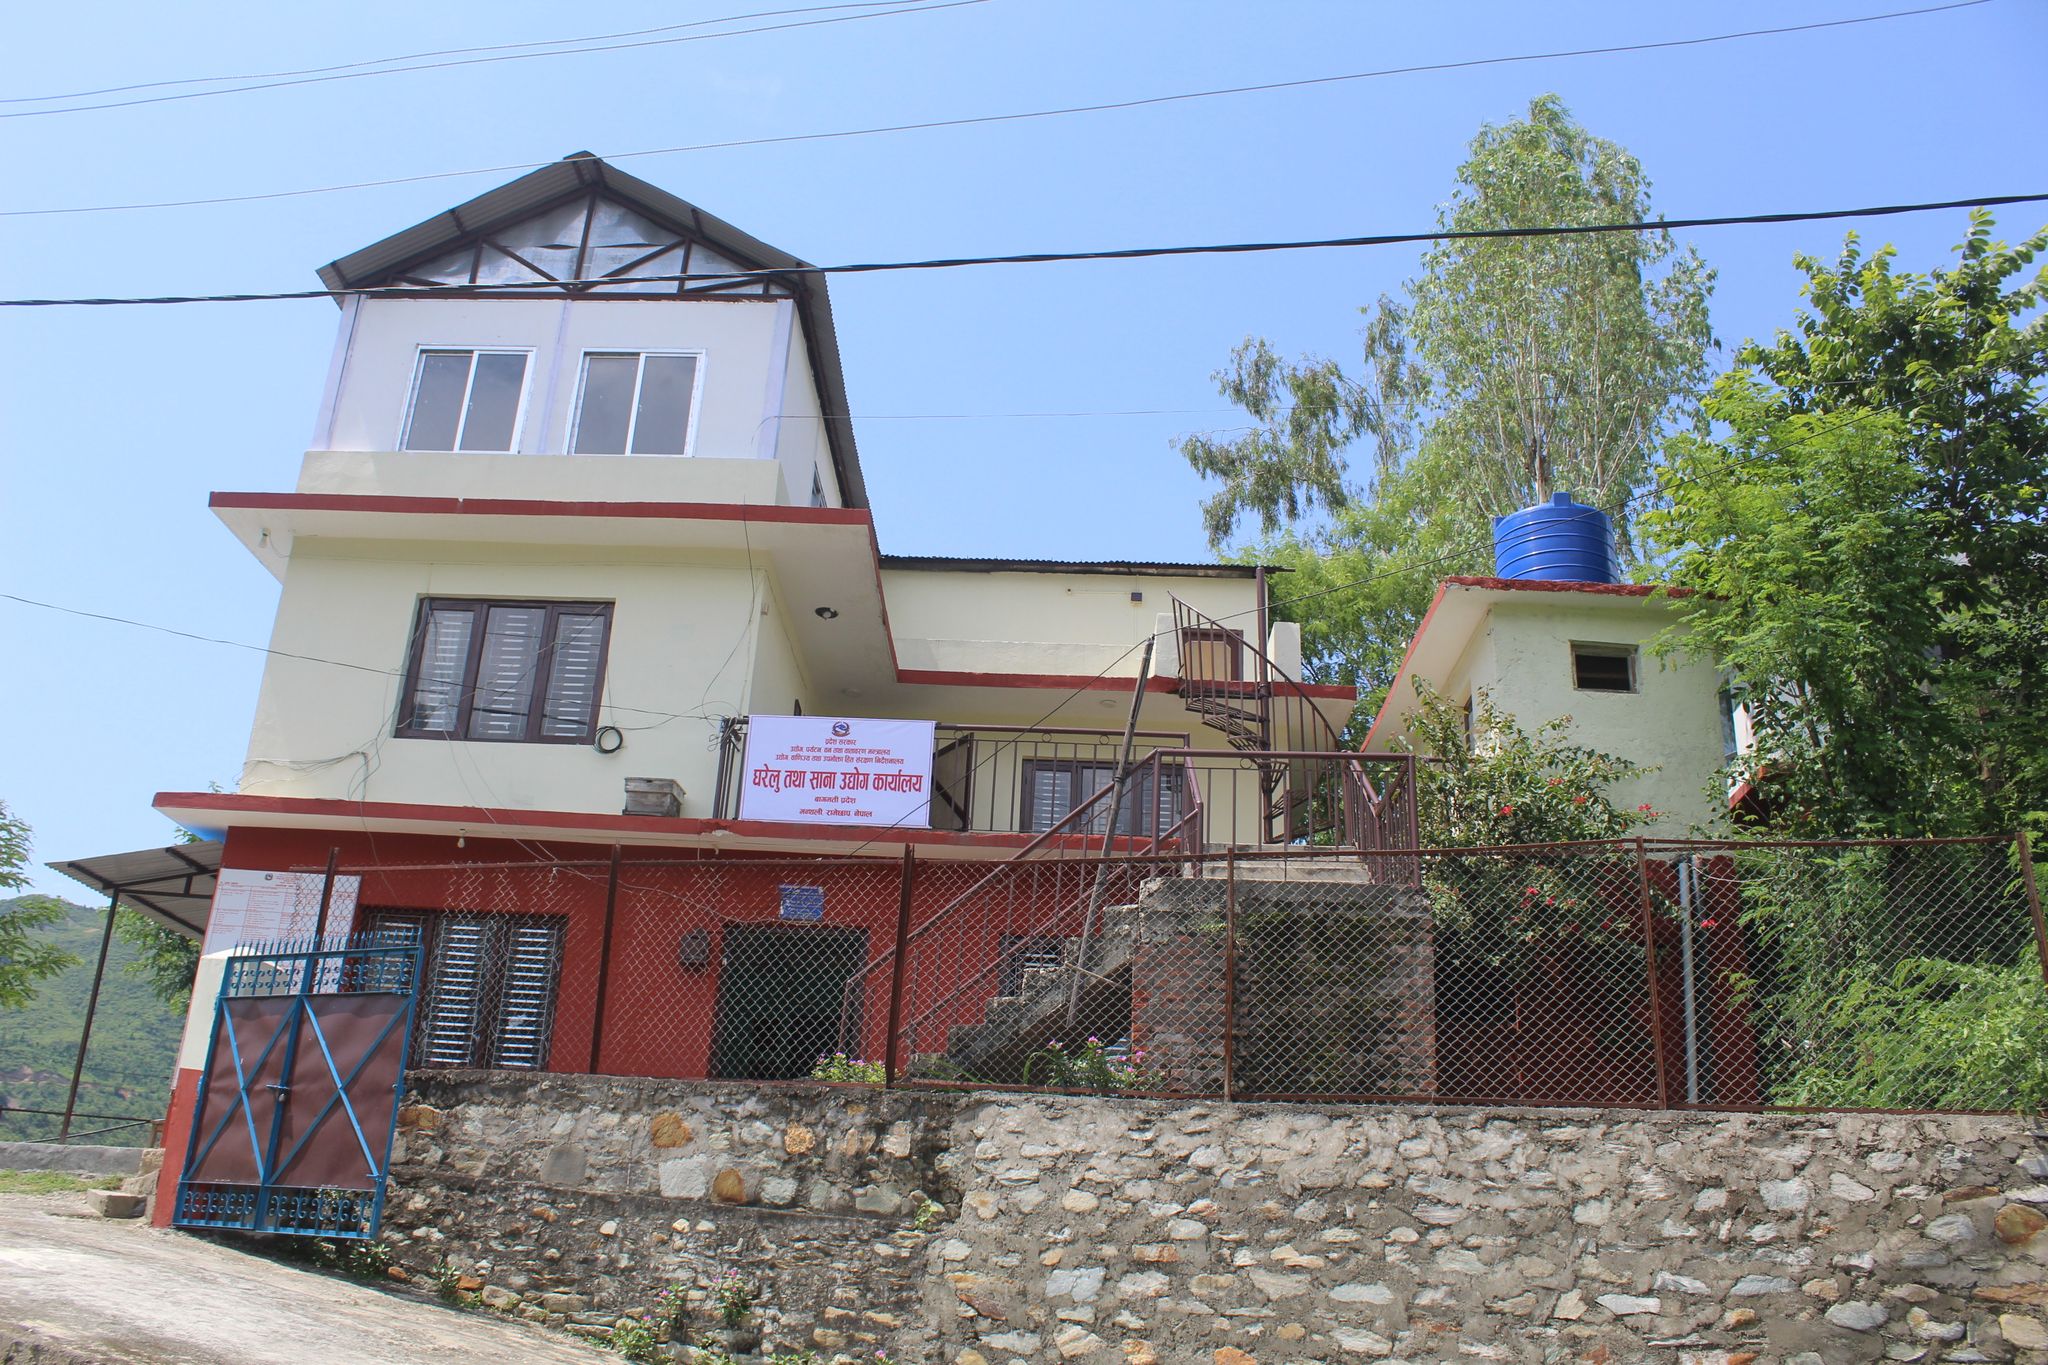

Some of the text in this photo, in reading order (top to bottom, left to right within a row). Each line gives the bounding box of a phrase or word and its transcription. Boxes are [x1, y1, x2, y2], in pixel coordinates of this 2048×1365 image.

[753, 763, 923, 793] घरेलु तथा साना उद्योग कार्यालय
